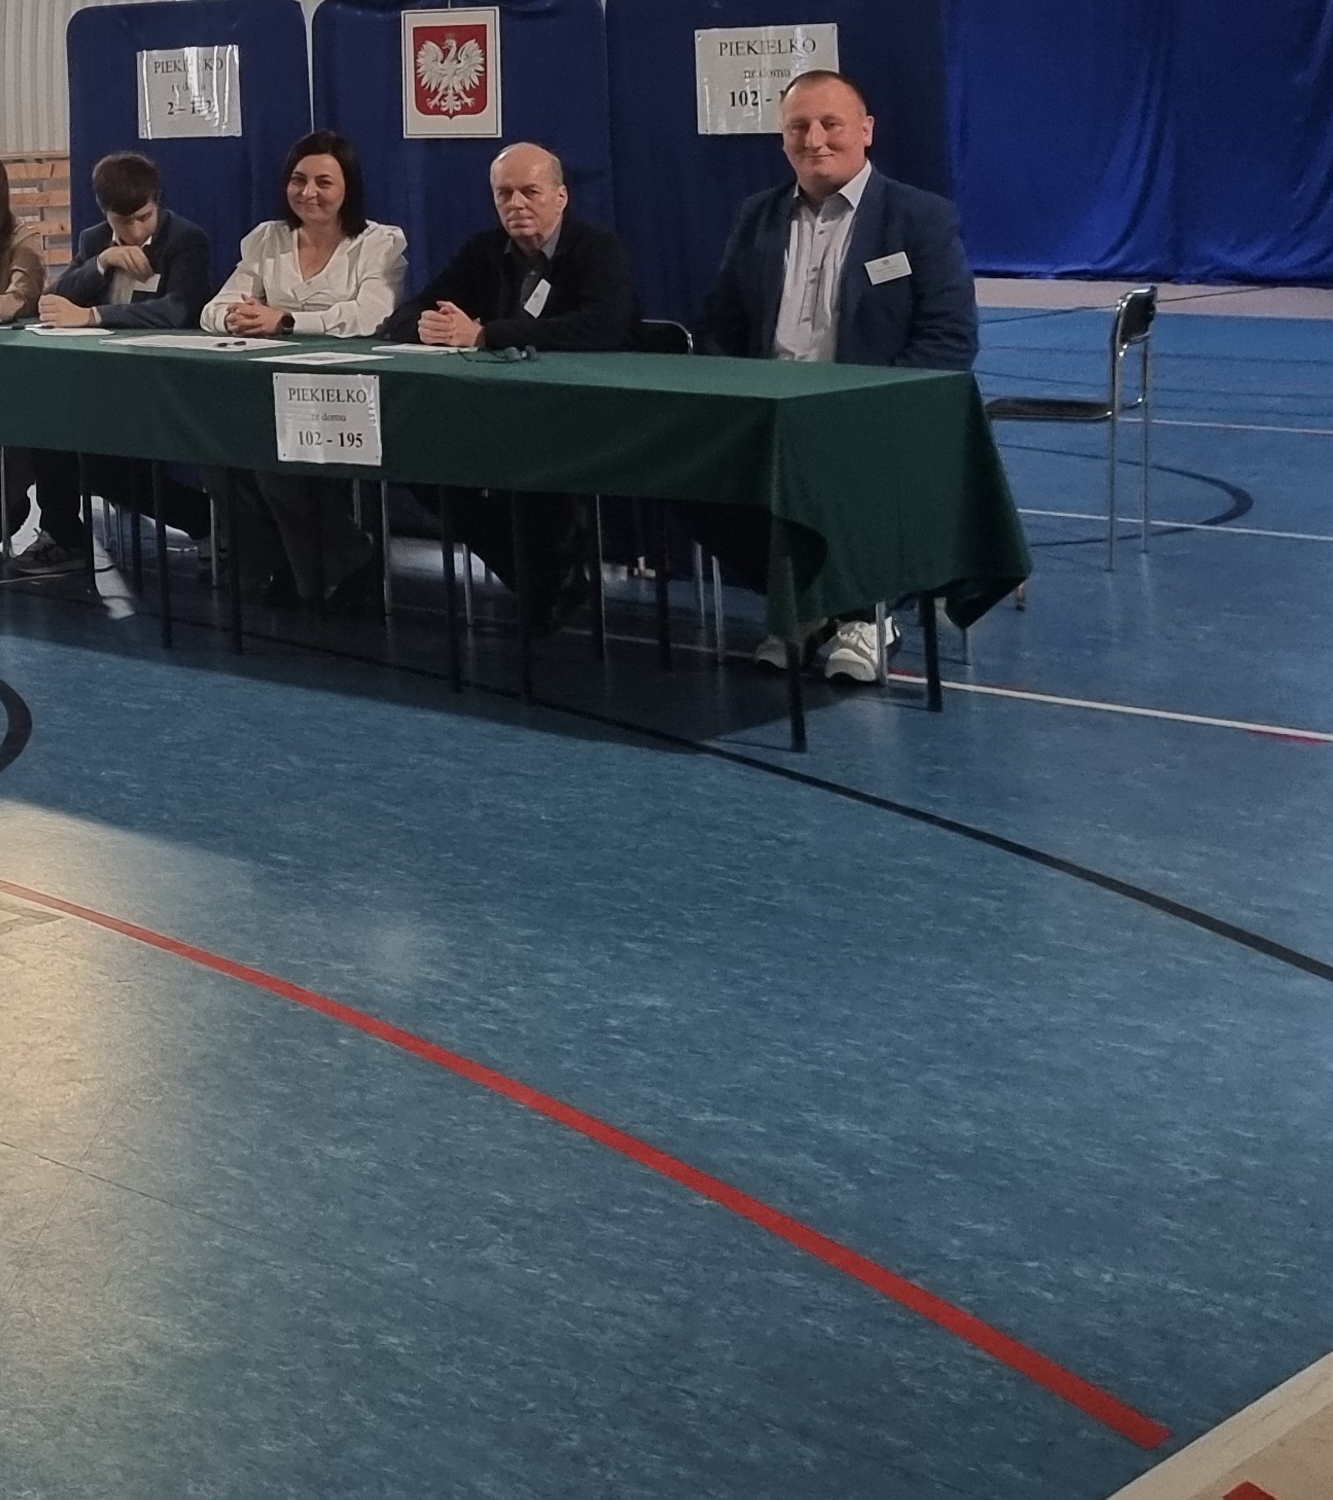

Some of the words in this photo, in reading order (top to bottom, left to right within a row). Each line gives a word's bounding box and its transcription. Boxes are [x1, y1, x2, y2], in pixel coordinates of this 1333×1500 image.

[730, 90, 759, 107] 102
[167, 101, 174, 115] 2
[191, 100, 213, 114] 12
[298, 431, 322, 446] 102
[338, 432, 363, 448] 195
